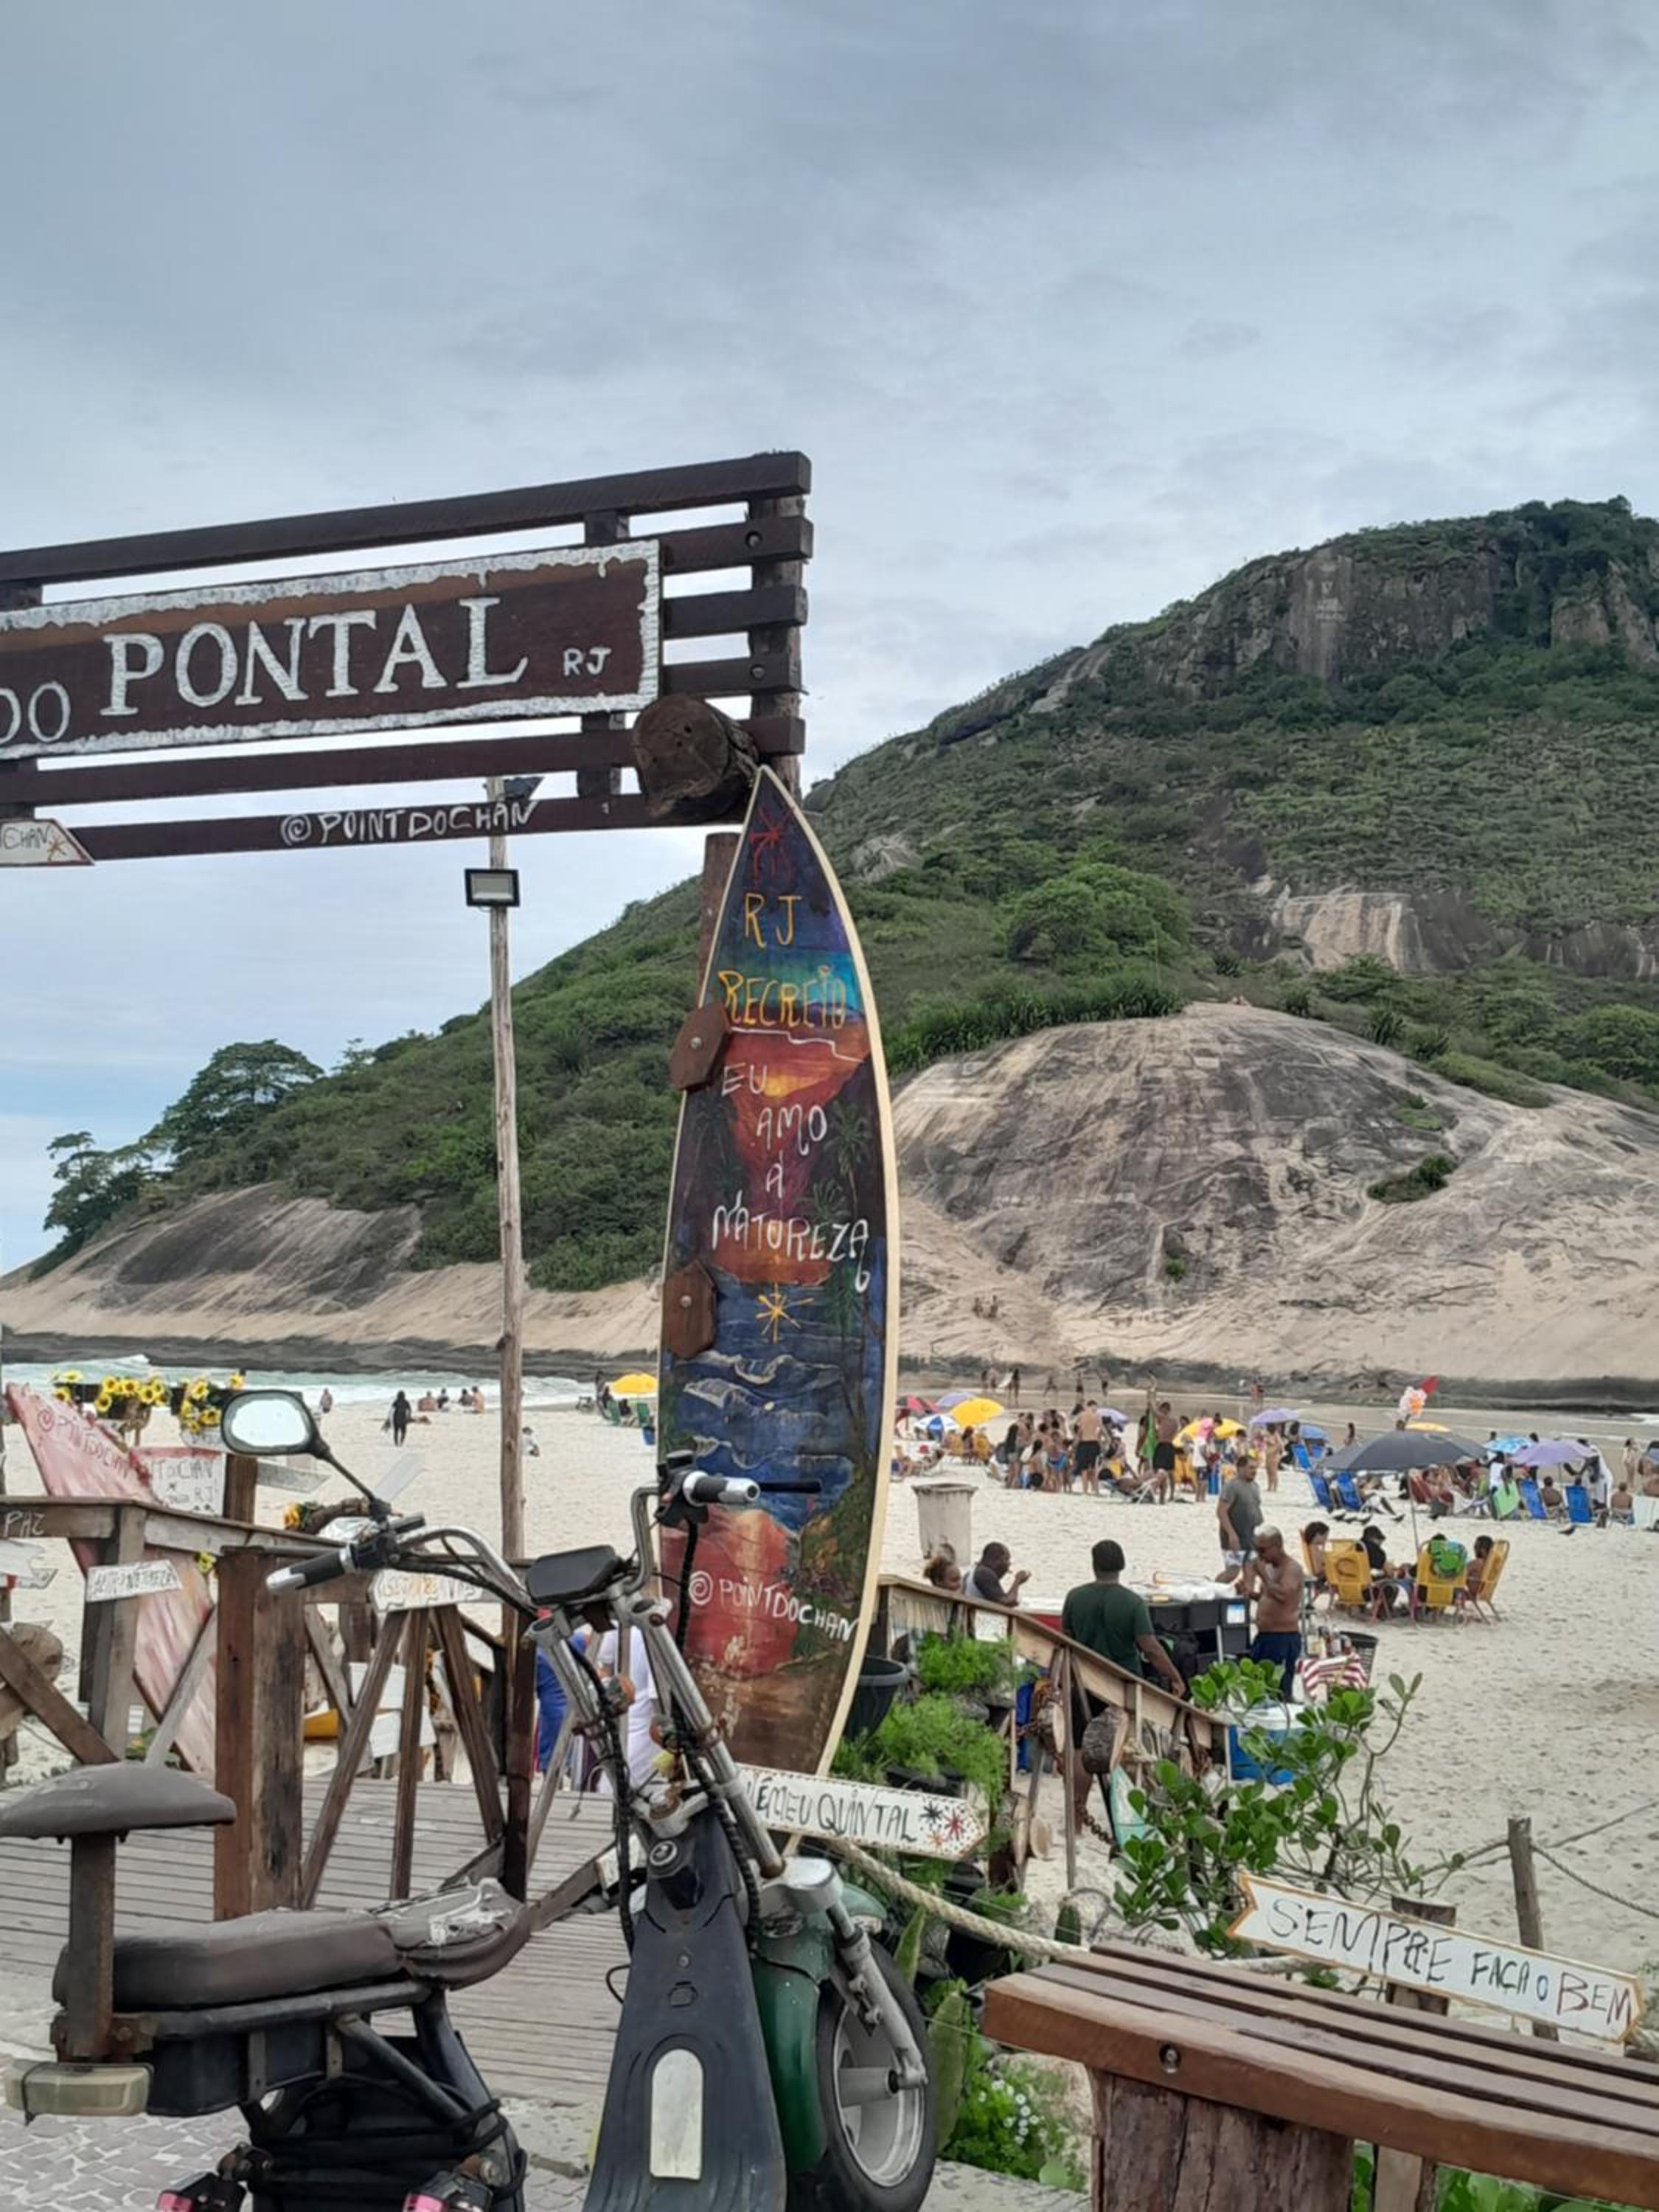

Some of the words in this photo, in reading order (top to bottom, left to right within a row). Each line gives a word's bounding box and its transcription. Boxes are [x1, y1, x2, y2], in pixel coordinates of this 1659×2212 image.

[100, 597, 528, 716] PONTAL
[563, 647, 612, 678] RJ
[721, 1062, 768, 1097] EU
[756, 1104, 827, 1156] AMO
[817, 1789, 917, 1843] QUINTAL
[1557, 1972, 1632, 2029] BEM
